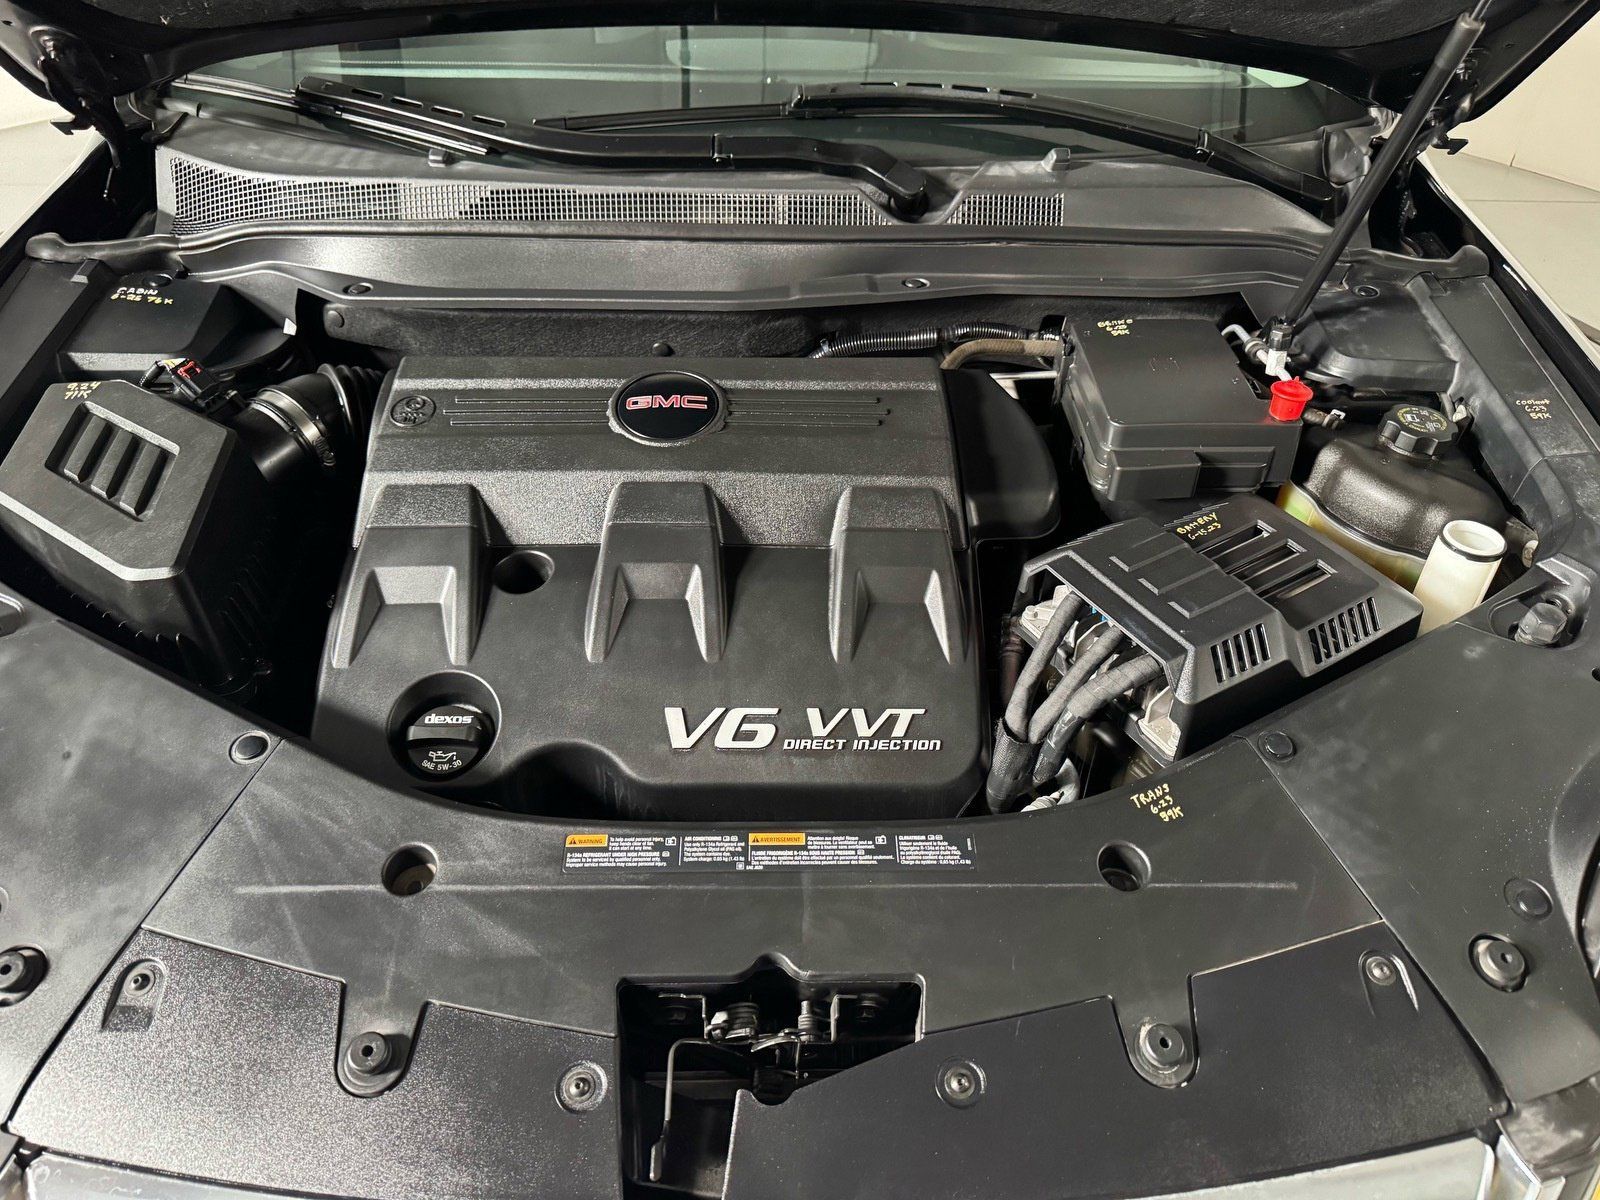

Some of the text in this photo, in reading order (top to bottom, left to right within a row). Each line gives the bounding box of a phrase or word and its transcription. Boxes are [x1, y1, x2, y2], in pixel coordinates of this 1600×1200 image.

[626, 395, 708, 410] GMC
[424, 713, 474, 724] dexos
[664, 707, 926, 749] V6 VVT
[783, 739, 942, 751] DIRECT INJECTION
[421, 760, 462, 771] SAE 5W-30
[1130, 783, 1169, 808] TRANS
[1150, 795, 1173, 814] 6.23
